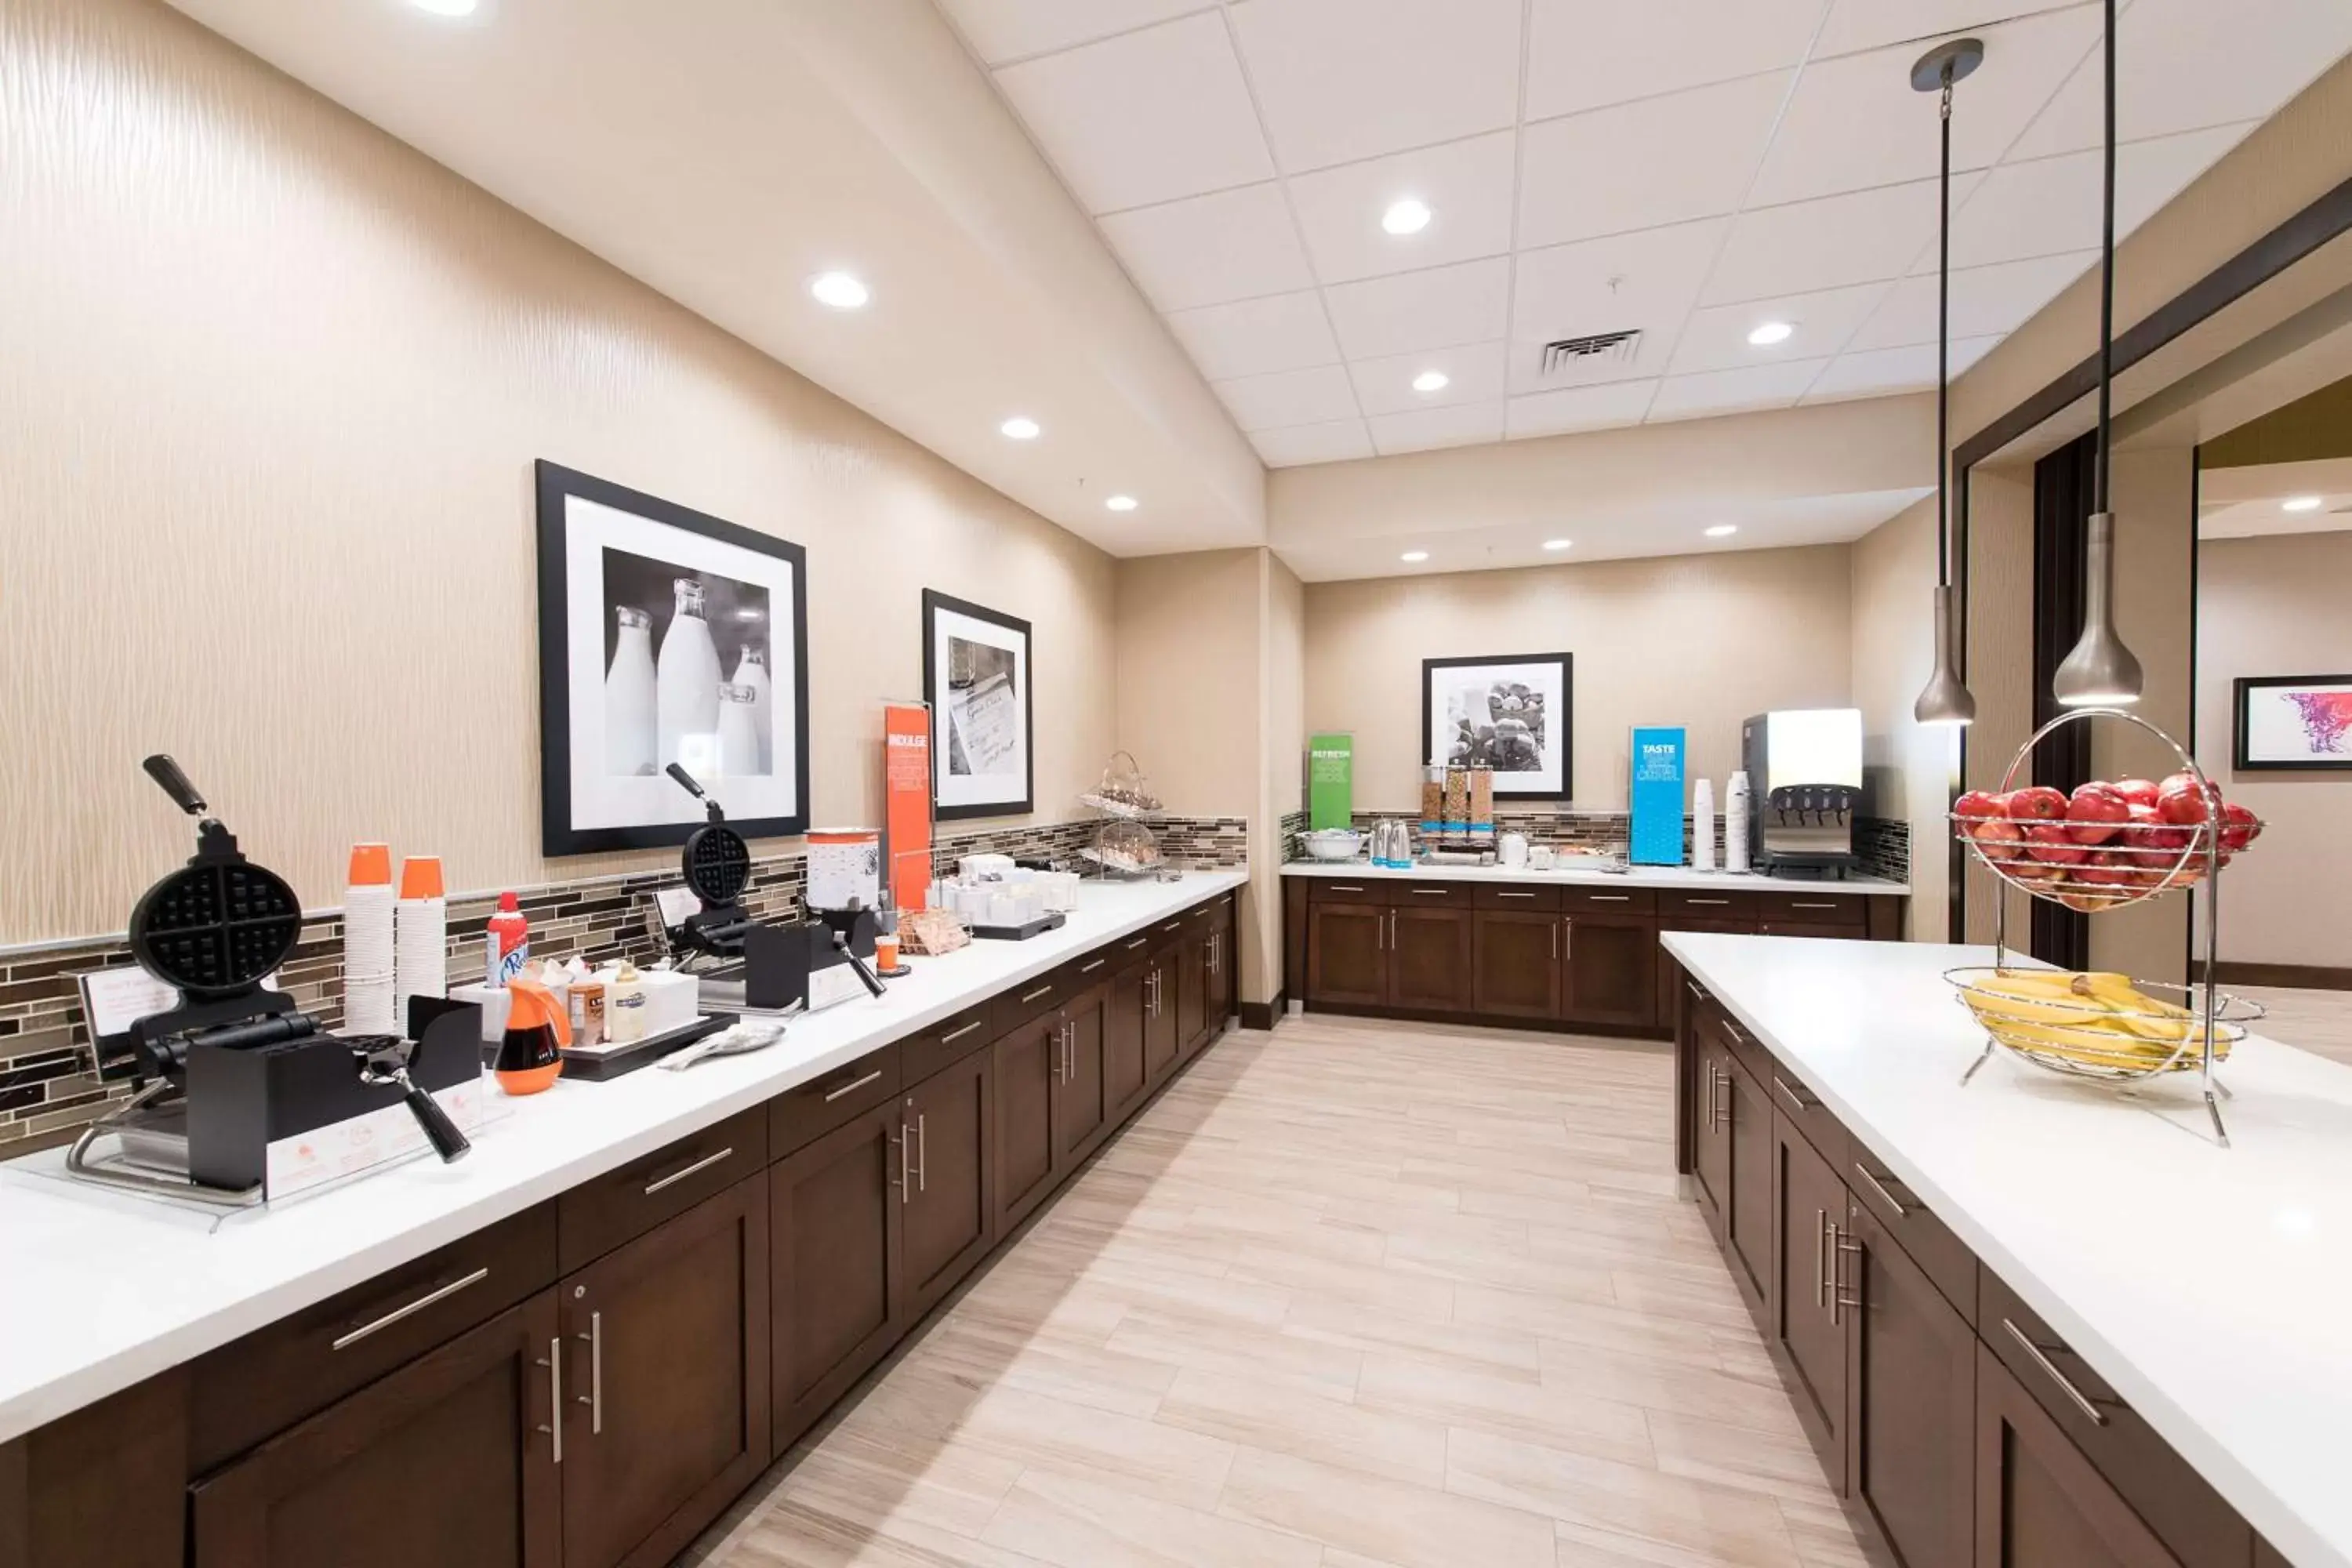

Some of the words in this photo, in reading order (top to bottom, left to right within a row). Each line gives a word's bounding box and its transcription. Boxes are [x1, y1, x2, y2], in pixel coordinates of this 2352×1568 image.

[888, 734, 928, 746] INDULGE
[1642, 744, 1675, 753] TASTE
[1312, 750, 1350, 759] REFRESH
